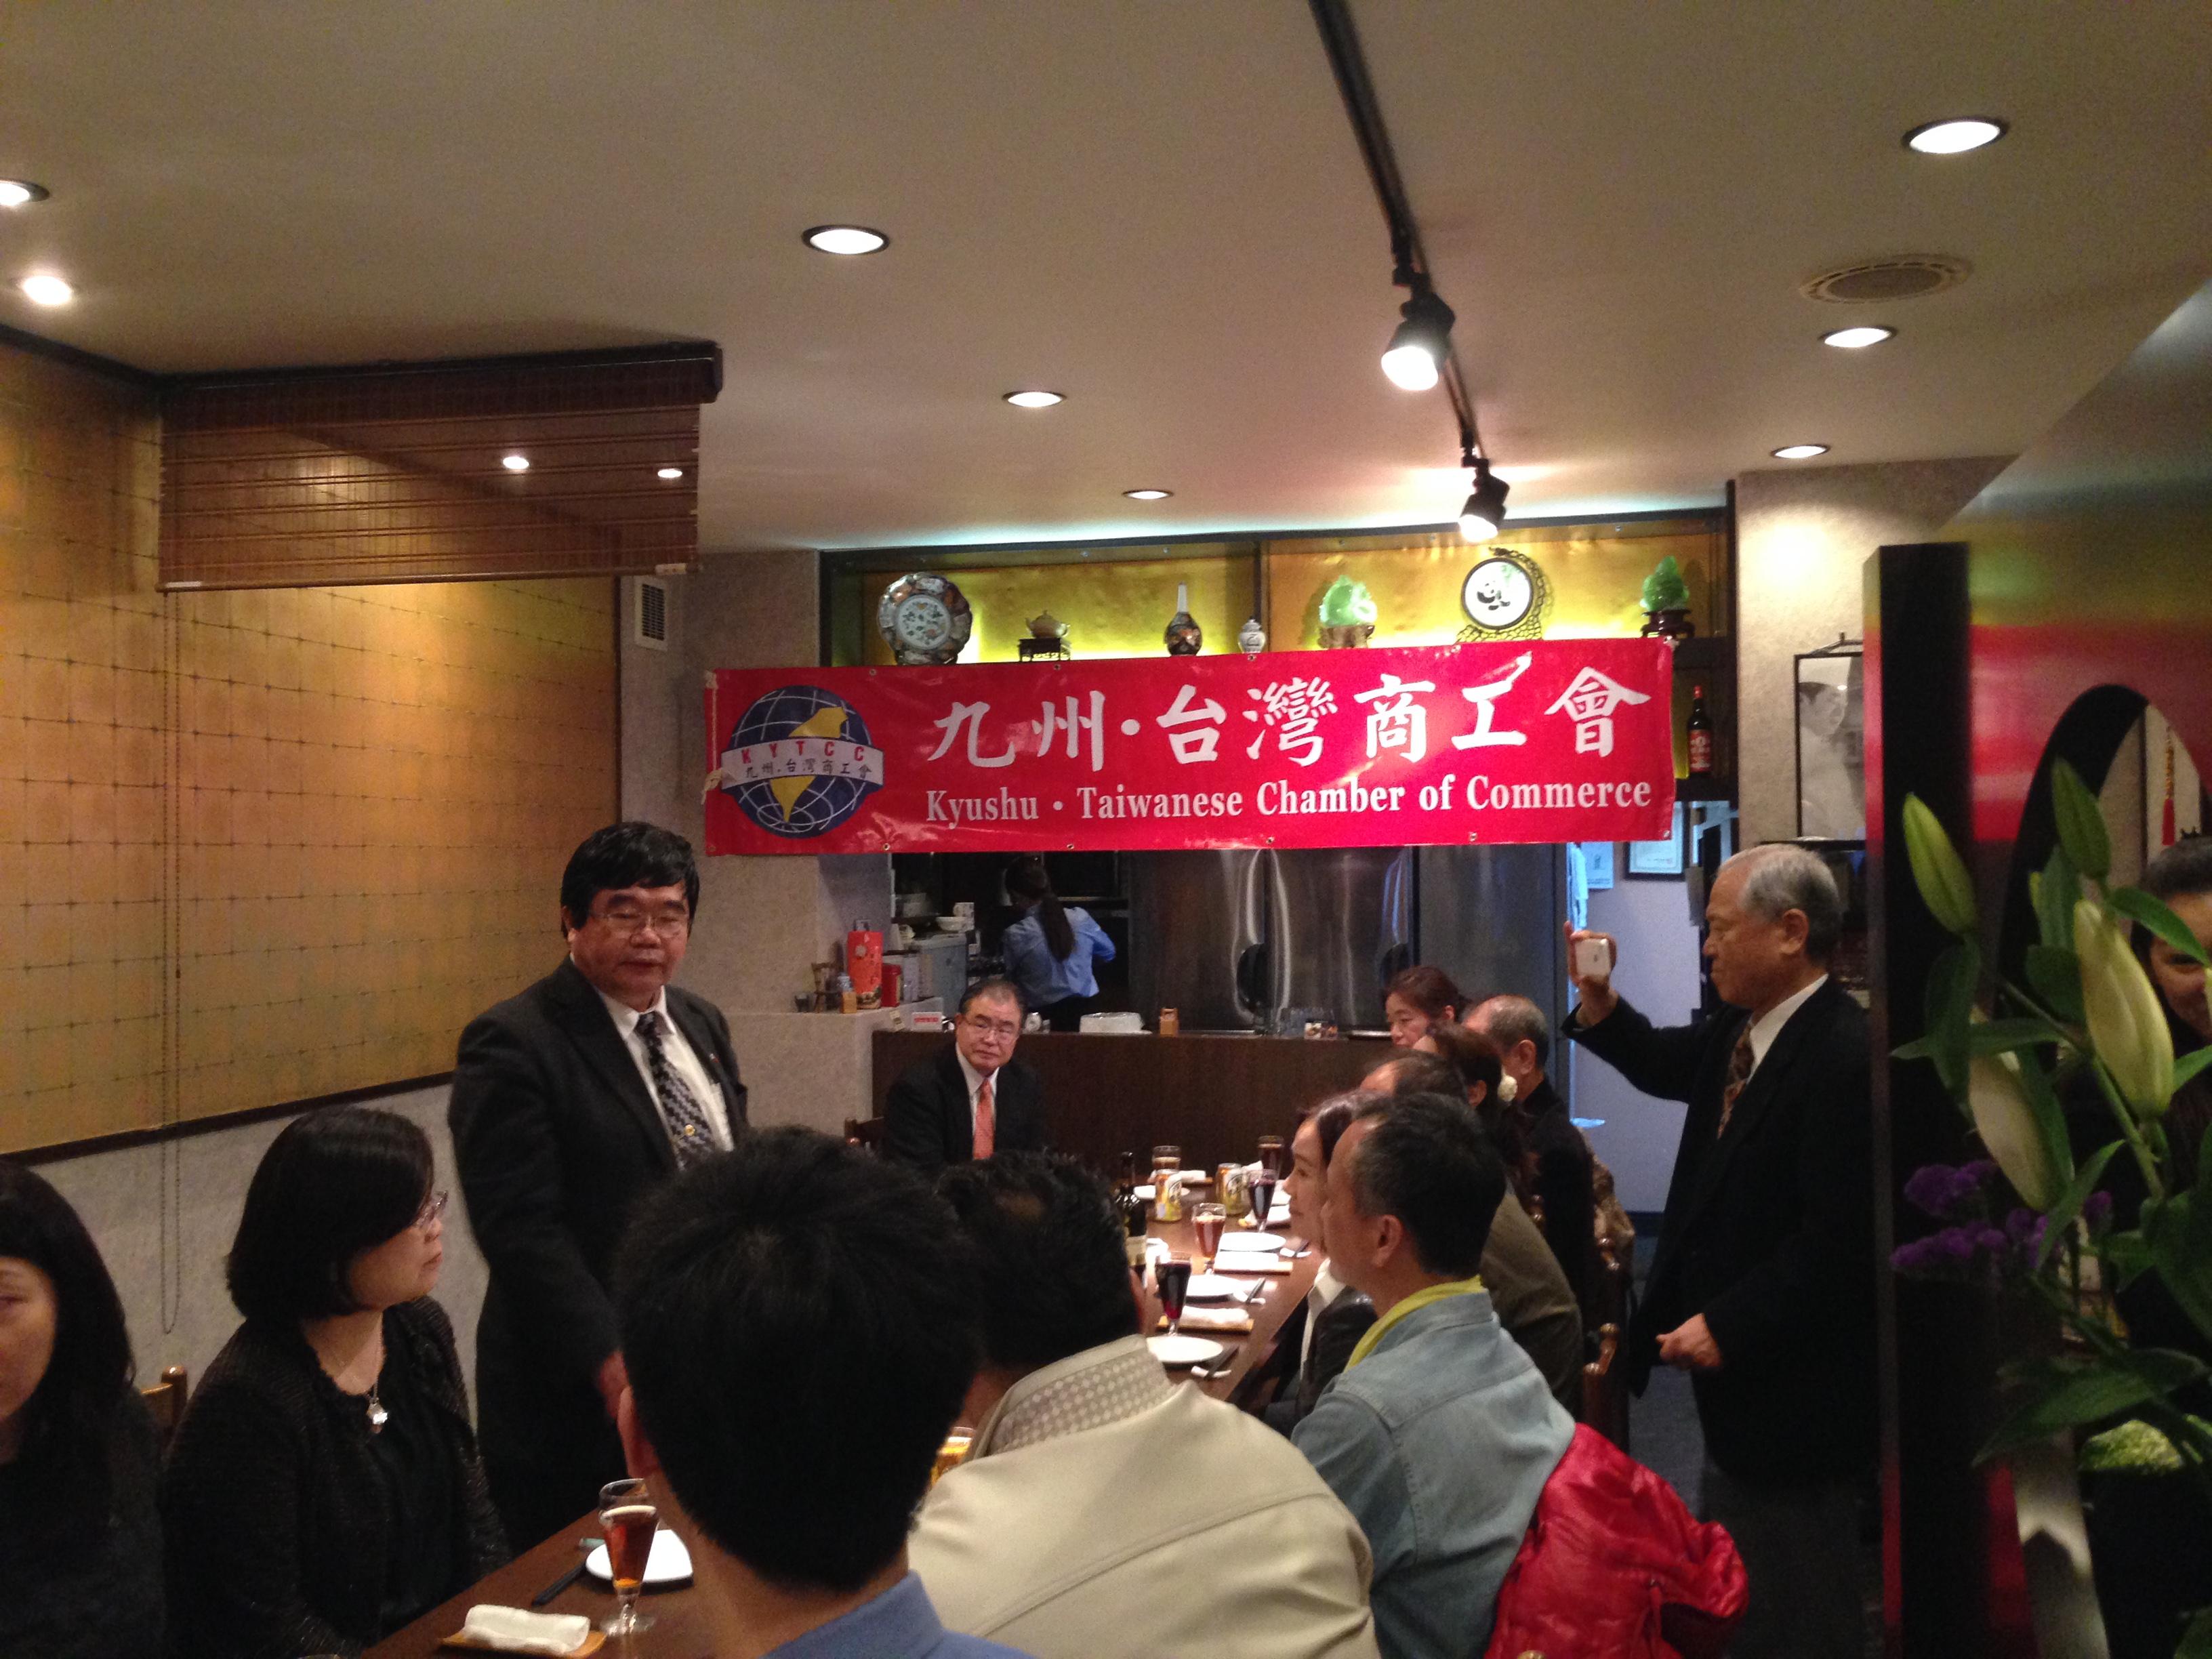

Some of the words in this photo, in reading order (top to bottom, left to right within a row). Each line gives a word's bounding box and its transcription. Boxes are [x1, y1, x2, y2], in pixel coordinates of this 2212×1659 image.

[926, 786, 1040, 830] Kyushu
[1077, 784, 1243, 820] Taiwanese
[1256, 779, 1406, 815] Chamber
[1419, 773, 1456, 811] of
[1467, 775, 1652, 811] Commerce
